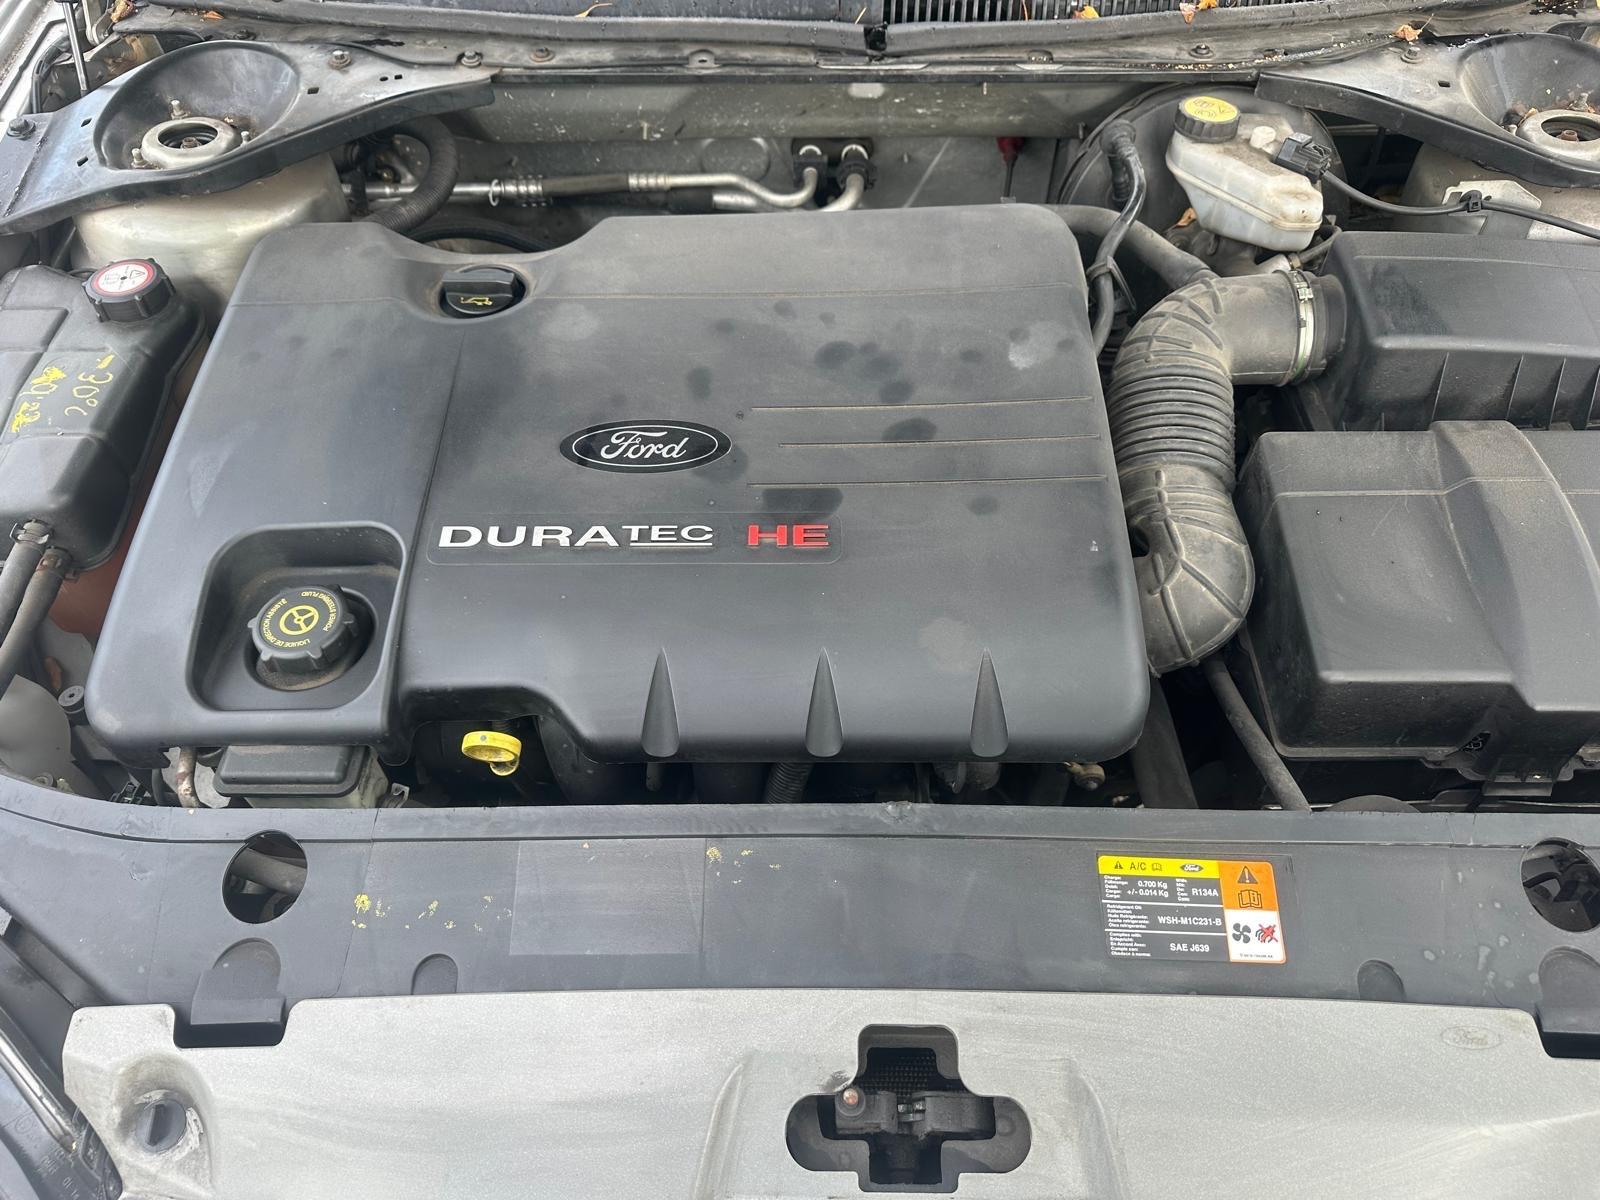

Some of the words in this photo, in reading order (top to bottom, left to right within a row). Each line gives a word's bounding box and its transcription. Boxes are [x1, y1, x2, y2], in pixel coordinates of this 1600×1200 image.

[600, 430, 687, 460] Ford
[438, 525, 714, 548] DURATEC
[747, 524, 830, 548] HE
[284, 638, 311, 648] LIQUIDE
[1129, 862, 1147, 871] A/C
[1137, 880, 1157, 888] 0.700
[1157, 881, 1168, 890] Kg
[1158, 889, 1169, 898] Kg
[1191, 888, 1219, 897] R134A
[1157, 915, 1222, 926] WSH-M1C231-B
[1169, 943, 1189, 952] SAE
[1189, 943, 1210, 952] J639
